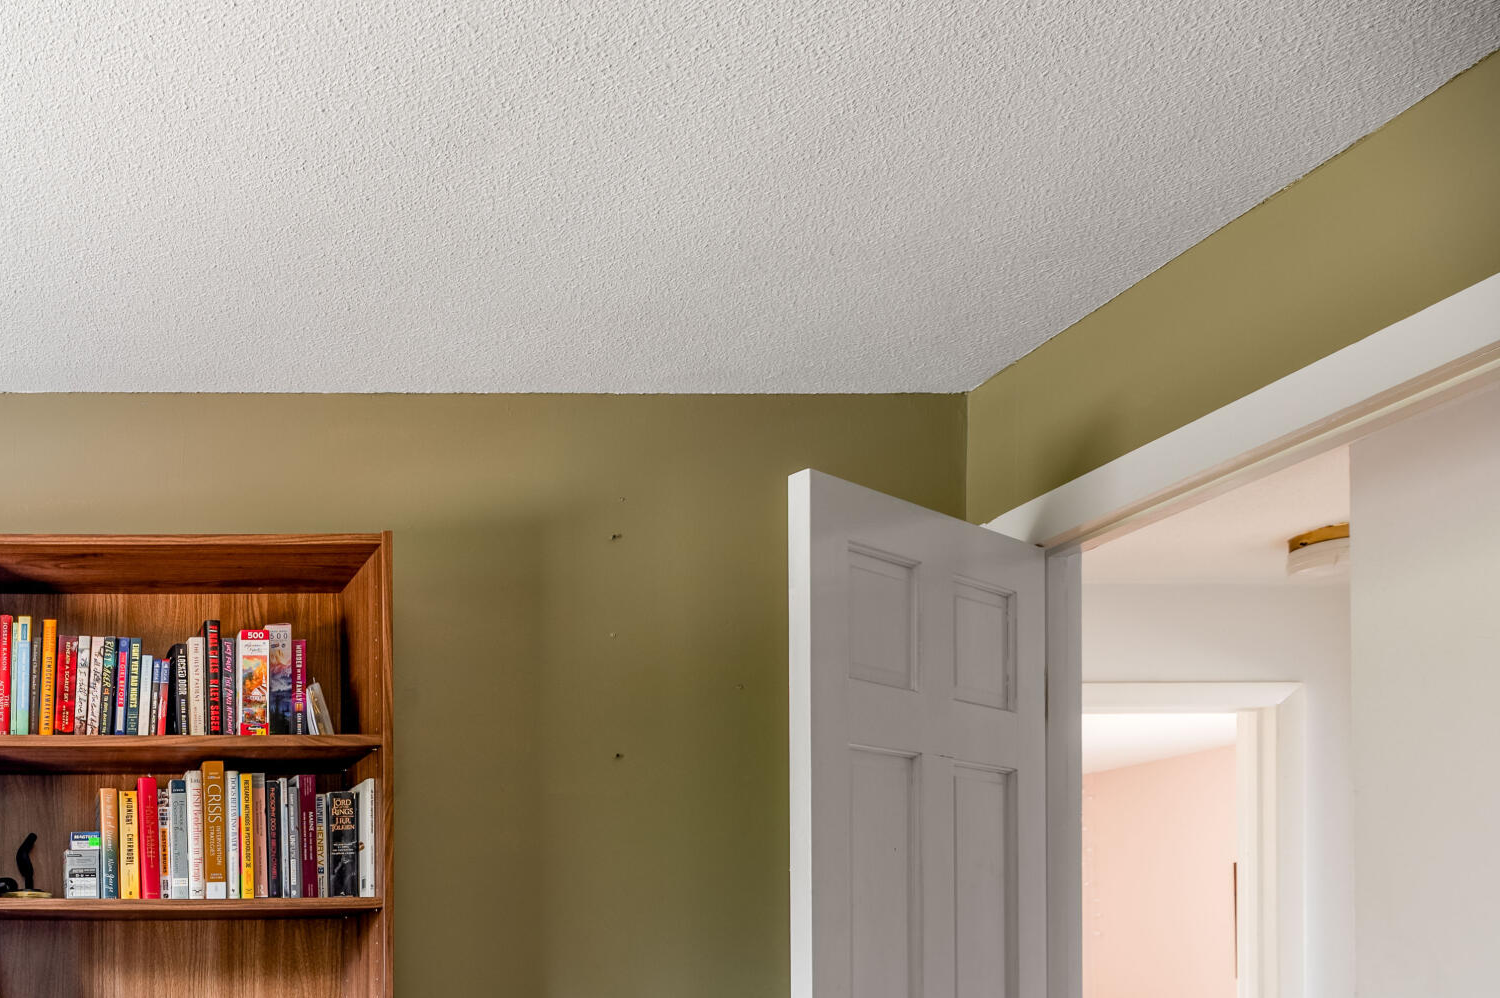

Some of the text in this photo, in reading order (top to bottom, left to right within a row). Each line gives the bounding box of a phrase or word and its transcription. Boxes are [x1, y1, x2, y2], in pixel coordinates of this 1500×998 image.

[247, 631, 264, 639] 500
[105, 641, 114, 661] RILEY
[224, 642, 234, 655] LUCY
[178, 655, 186, 677] LOCKED
[225, 656, 233, 672] FOLEY
[102, 665, 113, 687] SAGER
[209, 625, 220, 731] FINAL GIRLS RILEY SAGER
[178, 679, 187, 695] DOOR
[224, 688, 234, 705] PARIS
[207, 784, 222, 823] CRISIS
[333, 798, 352, 808] LORD
[192, 857, 203, 881] Therapy
[106, 874, 114, 892] George
